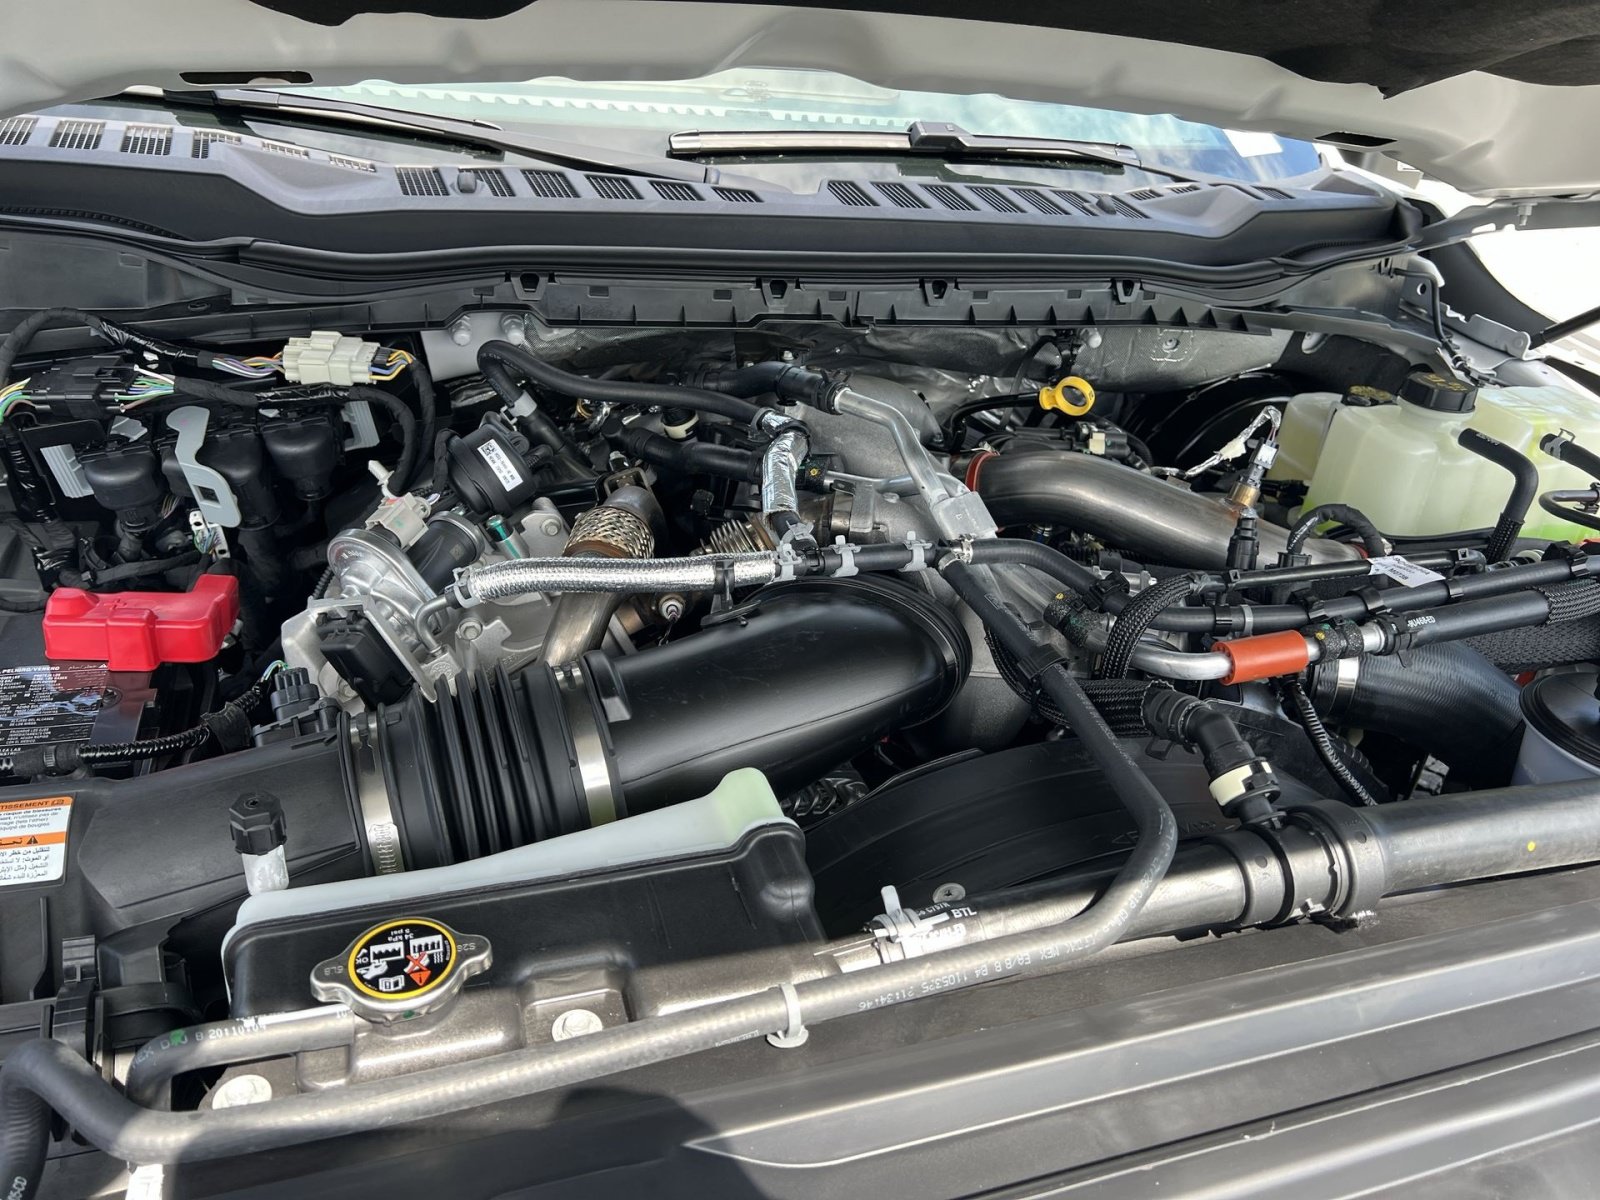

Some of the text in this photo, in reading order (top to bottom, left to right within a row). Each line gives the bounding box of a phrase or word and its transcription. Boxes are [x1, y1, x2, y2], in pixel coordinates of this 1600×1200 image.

[951, 907, 977, 919] BTL
[390, 928, 404, 936] psi
[387, 934, 404, 942] kPa
[356, 956, 369, 965] OK
